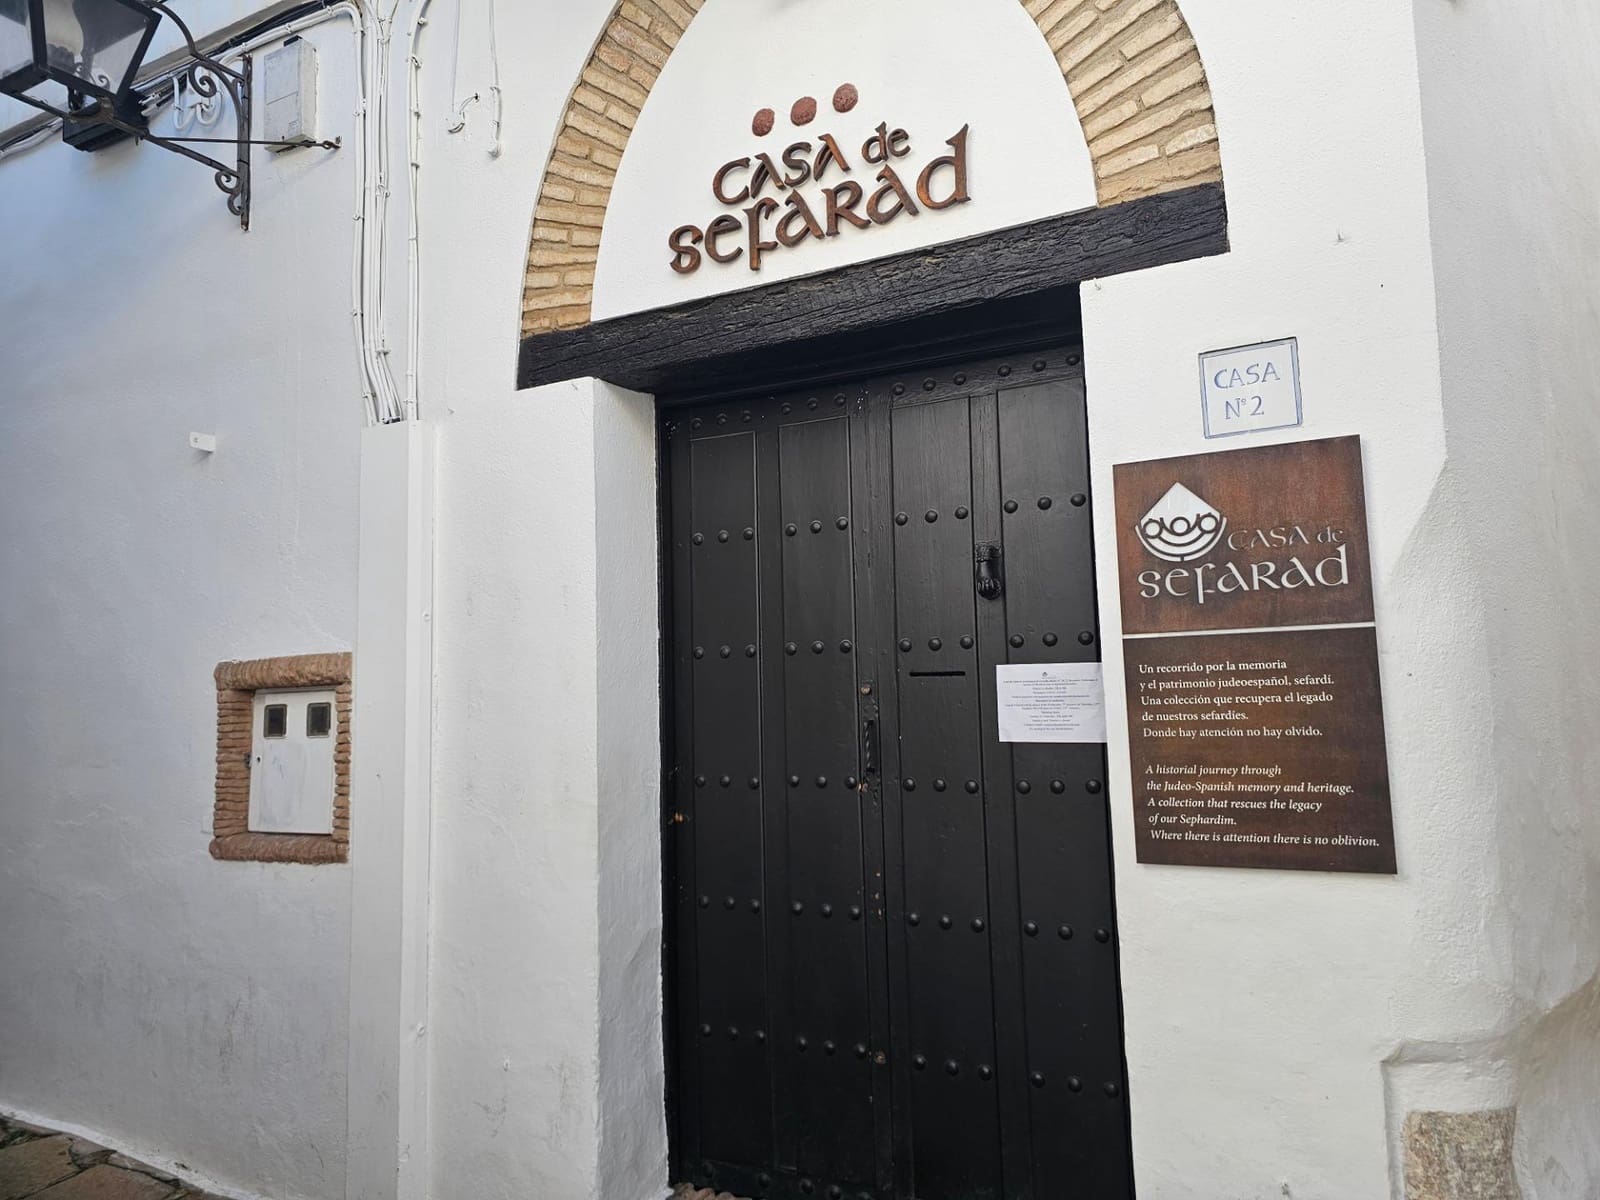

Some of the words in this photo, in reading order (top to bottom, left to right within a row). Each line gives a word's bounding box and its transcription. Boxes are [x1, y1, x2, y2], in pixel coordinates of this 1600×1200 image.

[861, 121, 912, 164] de
[1213, 361, 1281, 389] CASA
[1249, 395, 1265, 416] 2
[1316, 525, 1345, 545] de
[1139, 664, 1153, 674] Un
[1156, 662, 1203, 673] recorrido
[1205, 663, 1224, 675] por
[1226, 660, 1236, 671] la
[1238, 659, 1287, 671] memoria
[1139, 681, 1146, 691] y
[1147, 679, 1157, 689] el
[1159, 678, 1216, 691] patrimonio
[1217, 675, 1292, 690] judeoespañol,
[1141, 695, 1161, 706] Una
[1163, 694, 1211, 705] colección
[1213, 695, 1233, 707] que
[1235, 695, 1282, 706] recupera
[1284, 693, 1294, 703] el
[1297, 691, 1334, 703] legado
[1142, 712, 1154, 721] de
[1156, 712, 1198, 721] nuestros
[1143, 727, 1177, 738] Donde
[1179, 727, 1197, 739] hay
[1199, 726, 1244, 737] atención
[1246, 727, 1261, 737] no
[1263, 726, 1281, 739] hay
[1285, 725, 1323, 737] olvido.
[1145, 765, 1154, 775] A
[1156, 764, 1197, 775] historial
[1198, 765, 1239, 777] journey
[1241, 765, 1282, 776] through
[1146, 781, 1162, 791] the
[1164, 781, 1235, 793] Judeo-Spanish
[1237, 784, 1281, 794] memory
[1283, 783, 1305, 793] and
[1307, 783, 1355, 796] heritage.
[1147, 798, 1156, 807] A
[1158, 797, 1205, 808] collection
[1207, 798, 1228, 809] that
[1230, 800, 1267, 809] rescues
[1269, 799, 1287, 810] the
[1288, 800, 1322, 813] legacy
[1148, 813, 1160, 826] of
[1160, 815, 1178, 824] our
[1179, 814, 1237, 827] Sephardim.
[1150, 830, 1182, 841] Where
[1184, 831, 1210, 841] there
[1212, 831, 1221, 842] is
[1222, 832, 1270, 843] attention
[1273, 834, 1300, 845] there
[1303, 834, 1312, 845] is
[1314, 837, 1328, 846] no
[1331, 835, 1380, 848] oblivion.
